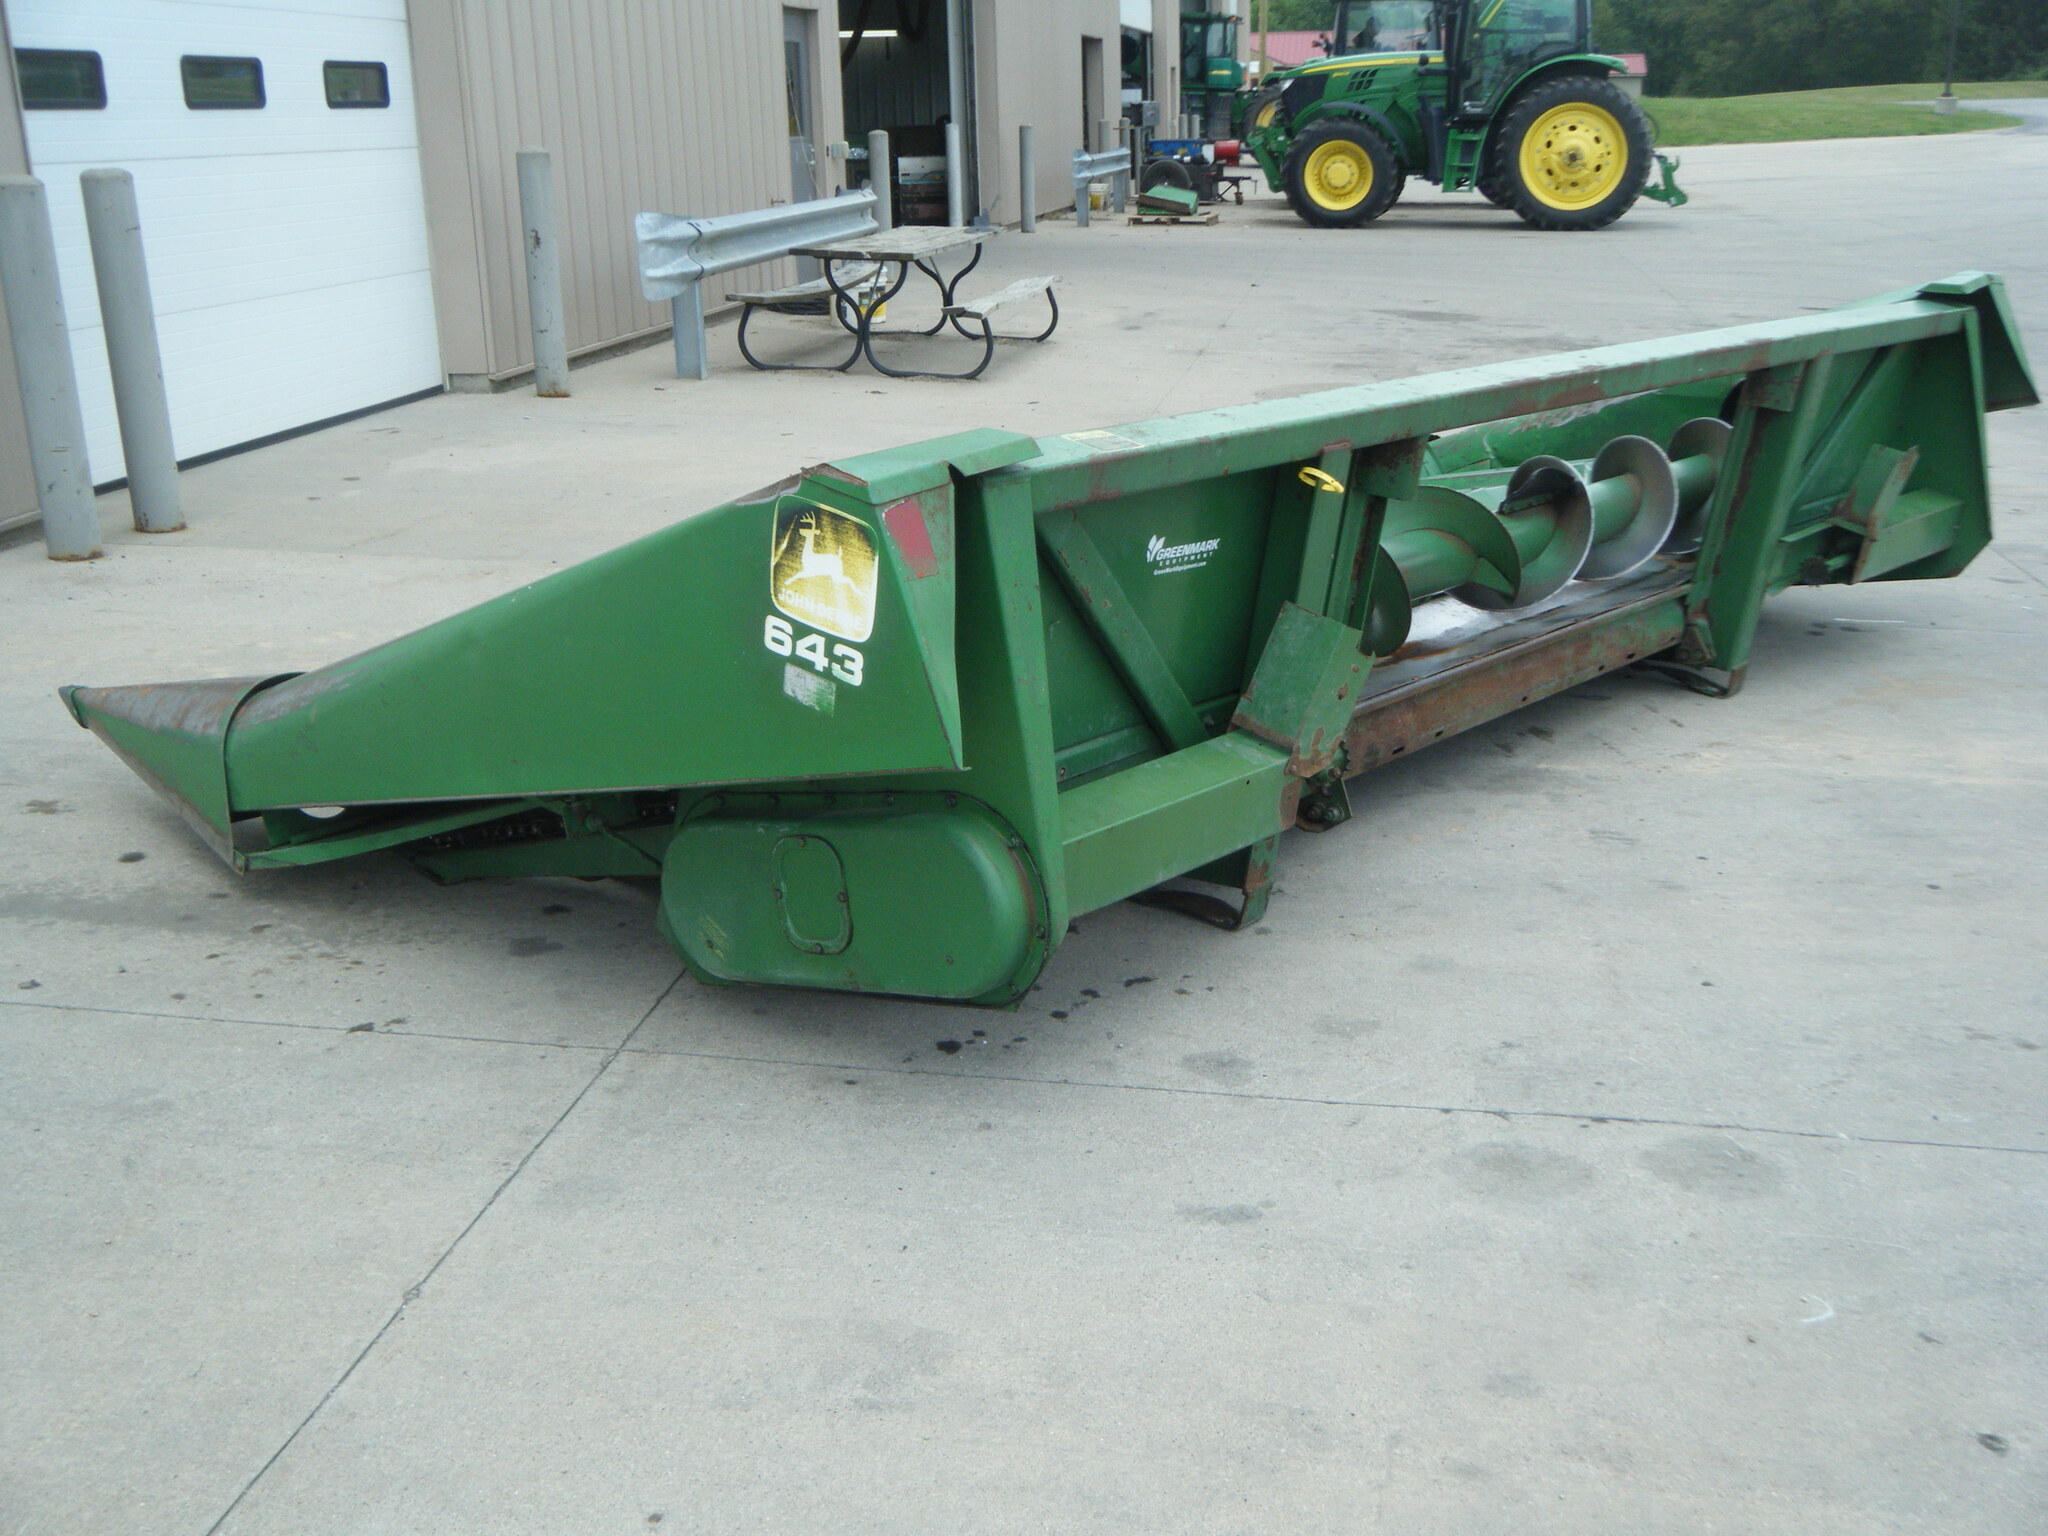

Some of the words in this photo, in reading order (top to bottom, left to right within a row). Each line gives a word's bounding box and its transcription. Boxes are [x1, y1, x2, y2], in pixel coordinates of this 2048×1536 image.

[1156, 538, 1220, 560] GREENMARK
[1159, 552, 1213, 566] EQUIPMENT
[778, 588, 814, 612] JOHN
[764, 614, 864, 687] 643
